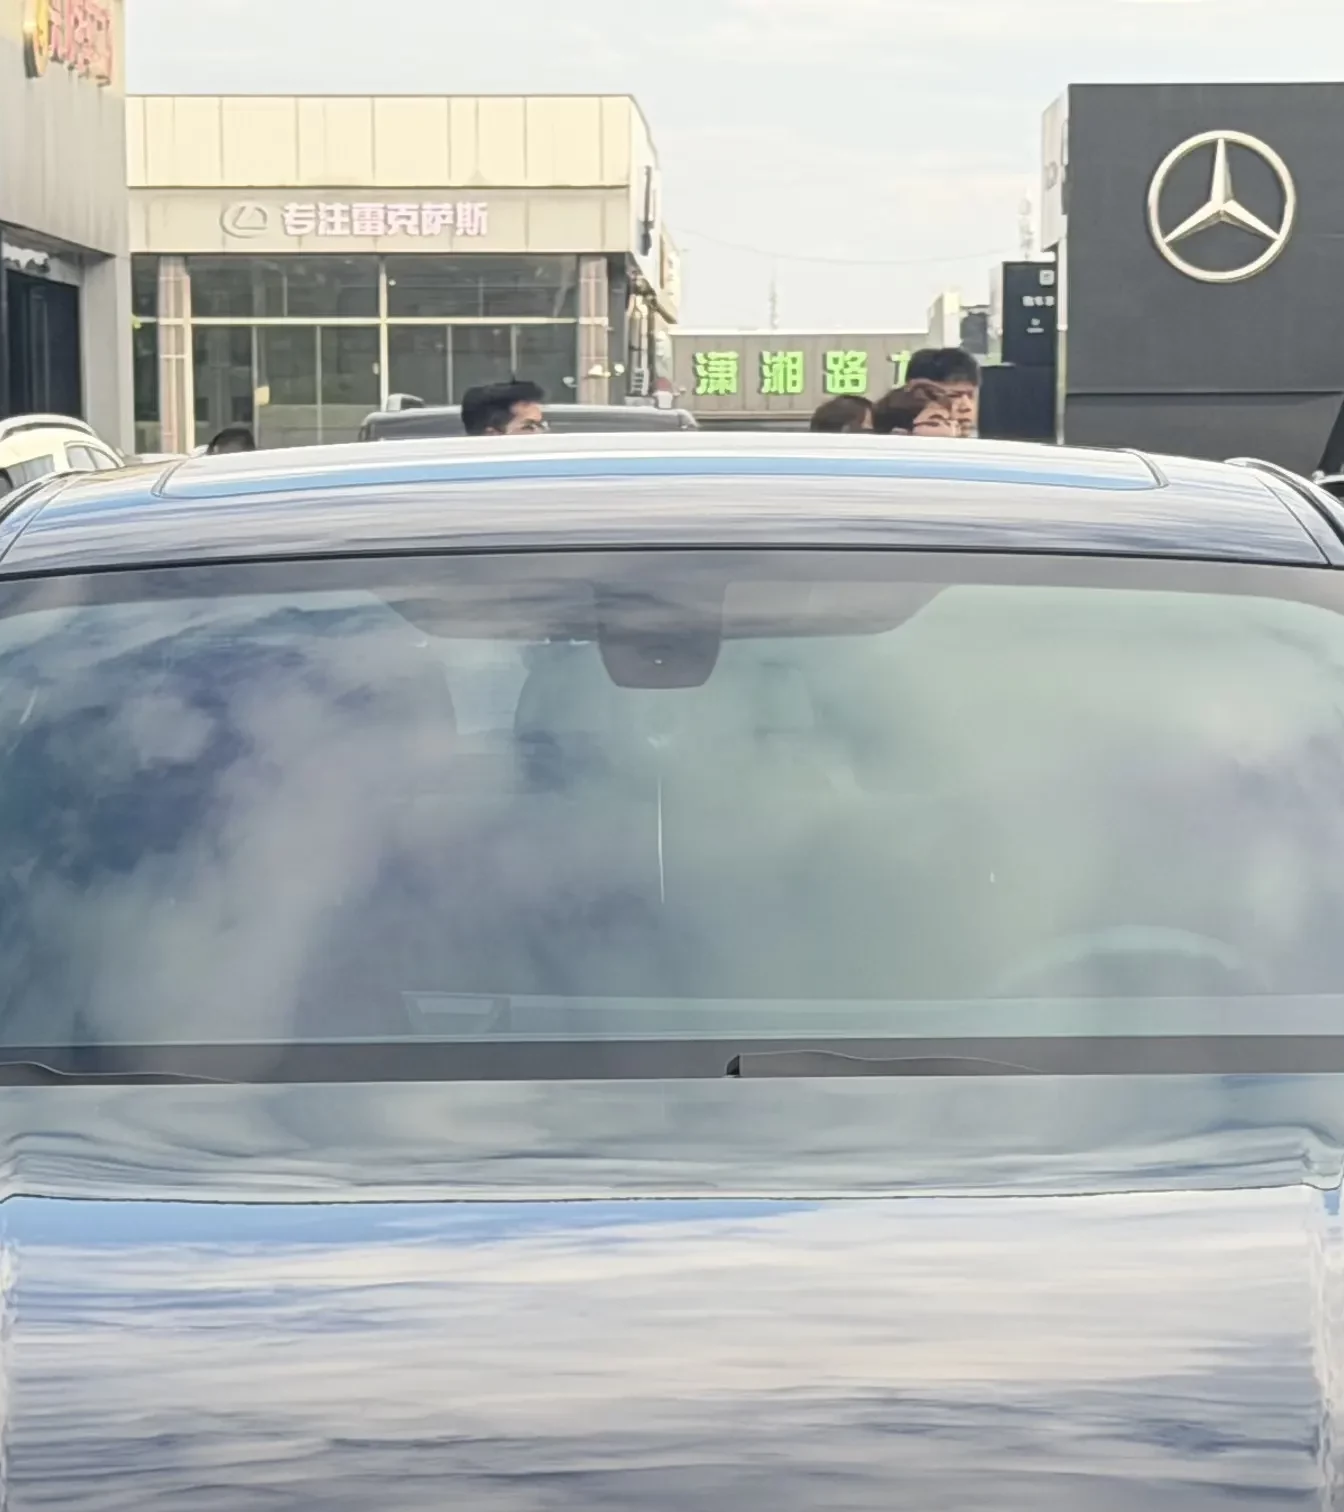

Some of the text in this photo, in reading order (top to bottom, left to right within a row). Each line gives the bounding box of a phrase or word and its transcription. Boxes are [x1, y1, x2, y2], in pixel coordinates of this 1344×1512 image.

[283, 202, 488, 237] 专注雷克萨斯
